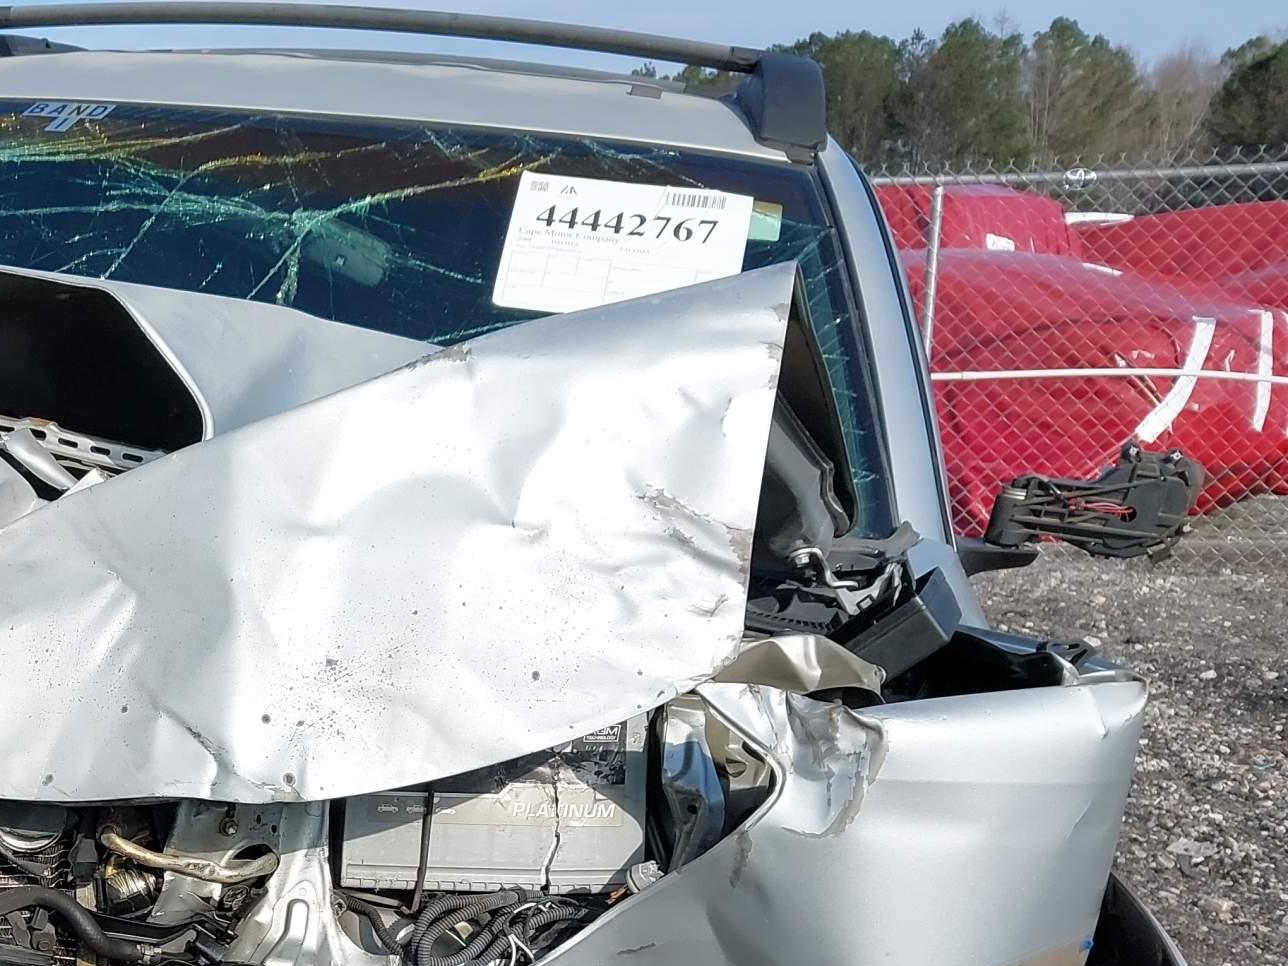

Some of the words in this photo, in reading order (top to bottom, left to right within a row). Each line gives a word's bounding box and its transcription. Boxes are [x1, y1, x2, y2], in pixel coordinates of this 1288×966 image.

[27, 102, 109, 117] BAND
[536, 204, 719, 244] 44442767
[512, 802, 616, 818] PLATINUM
